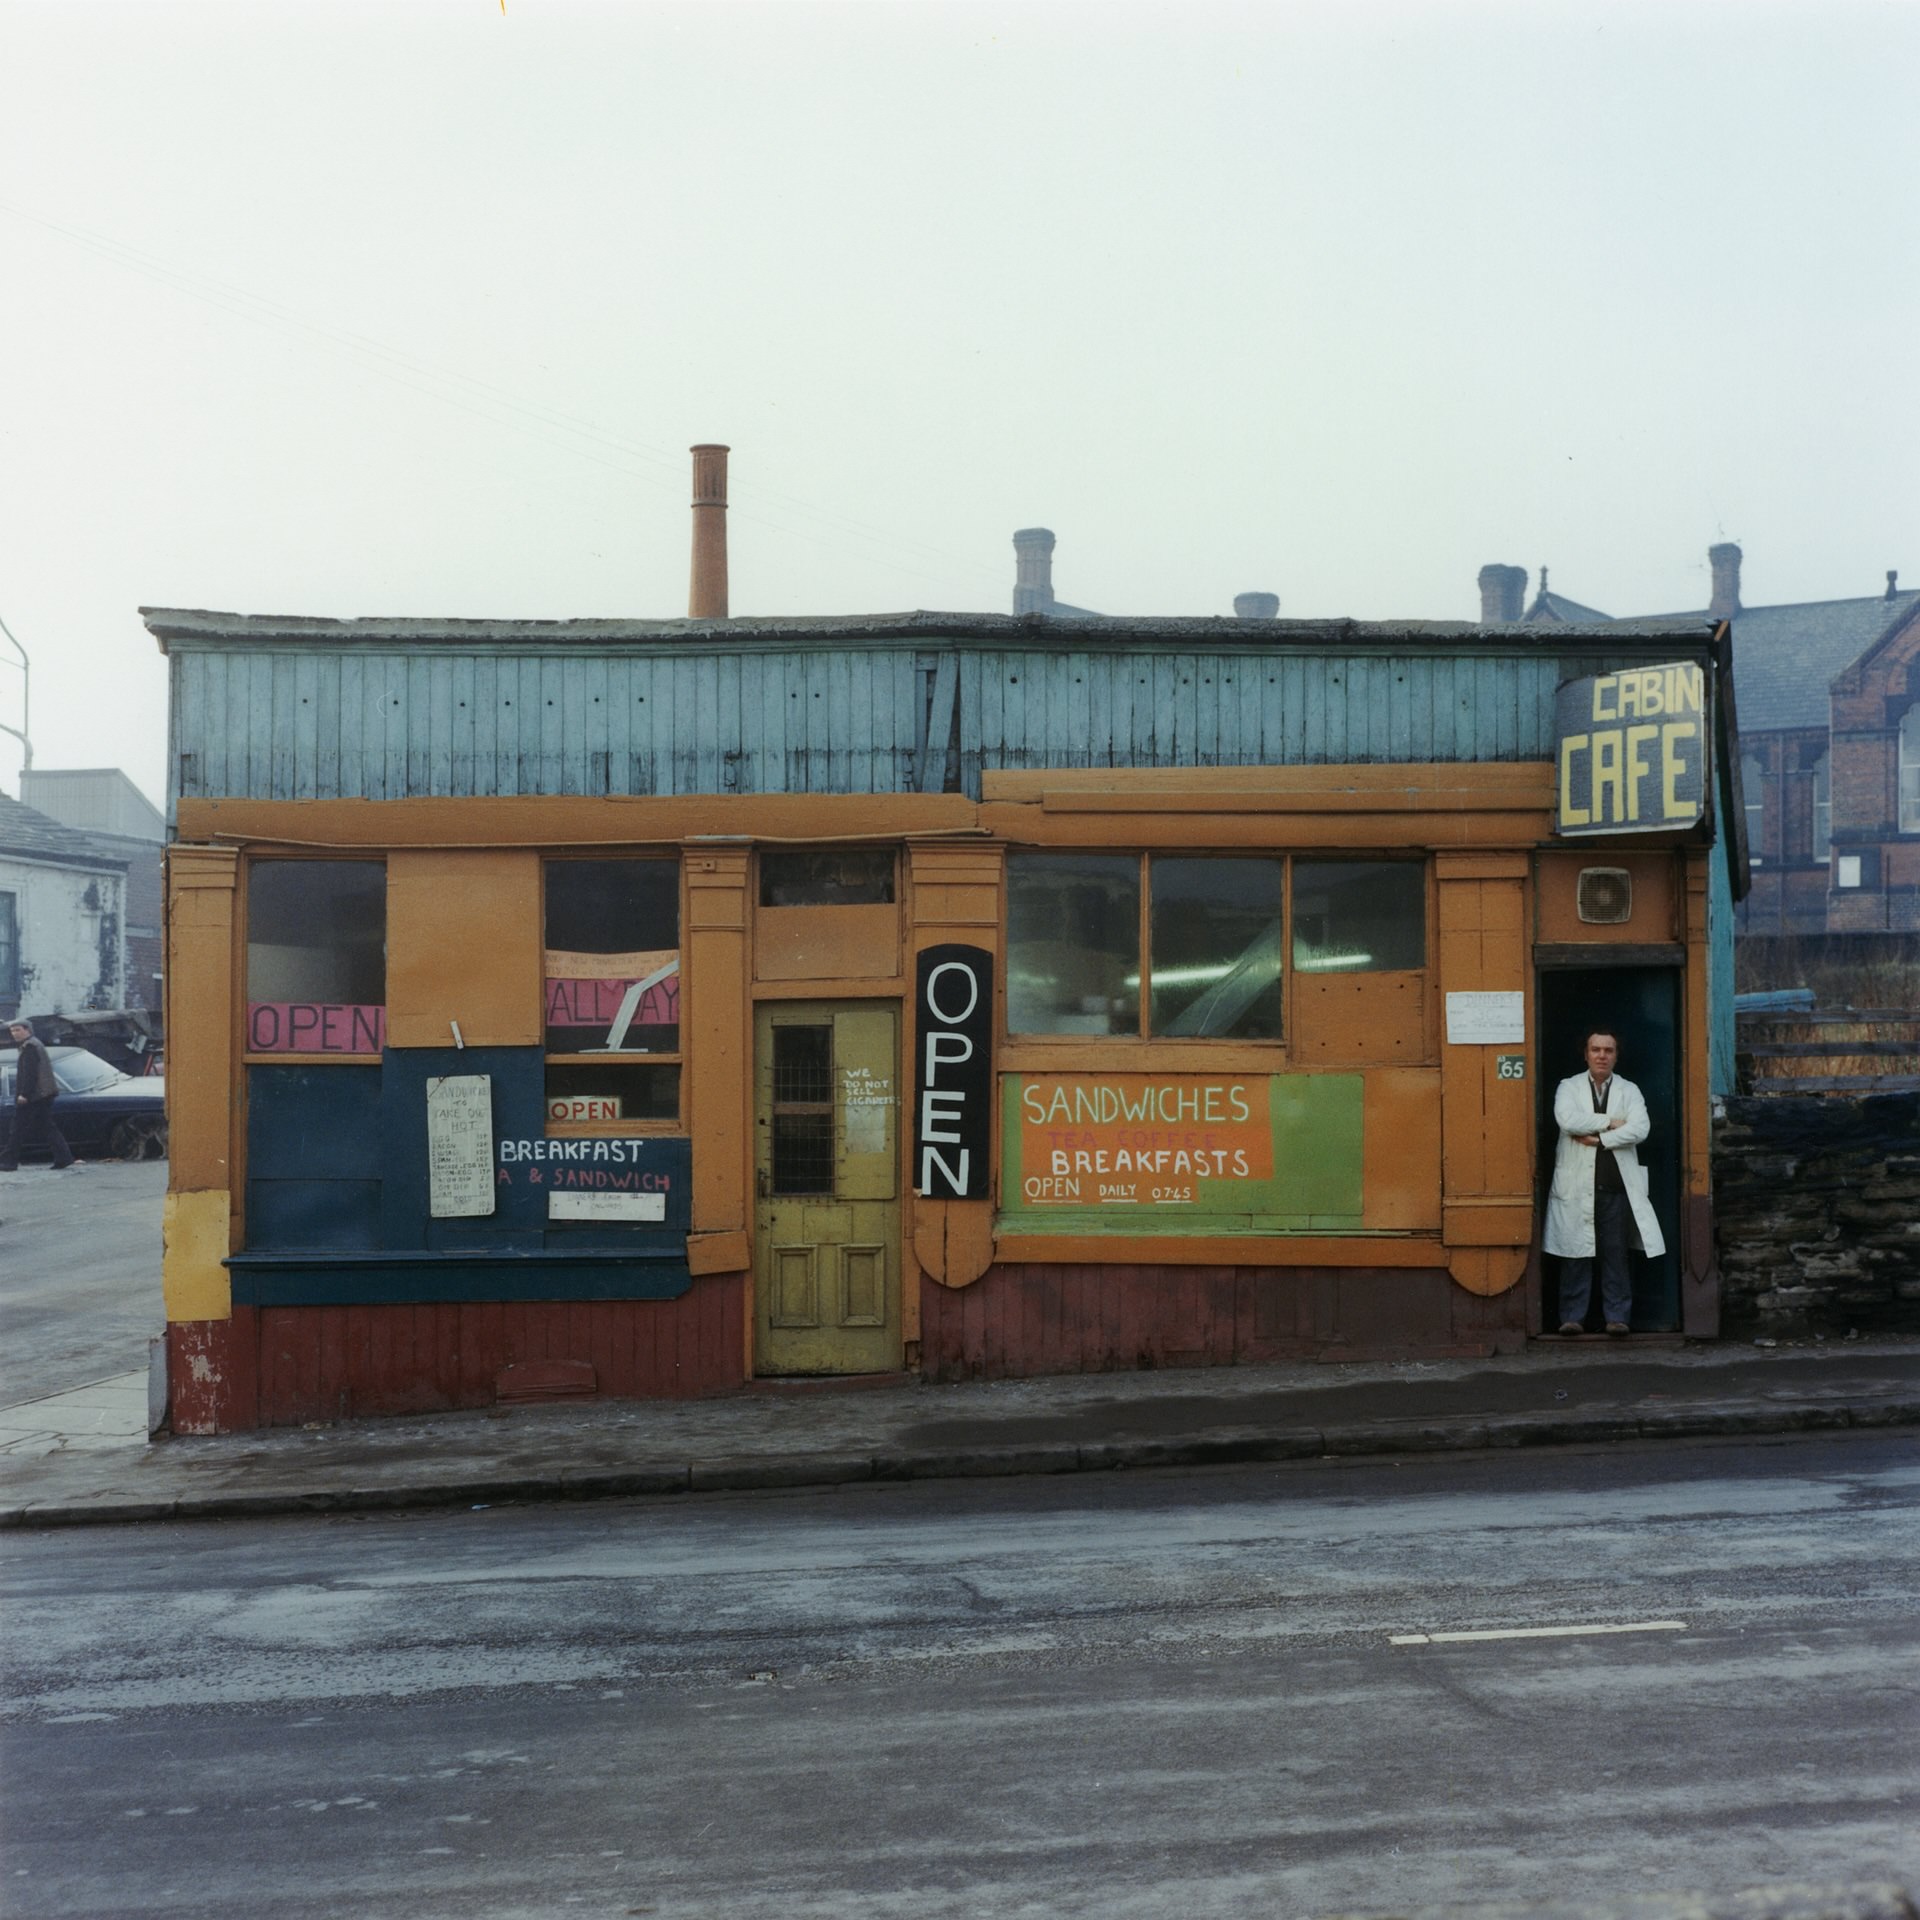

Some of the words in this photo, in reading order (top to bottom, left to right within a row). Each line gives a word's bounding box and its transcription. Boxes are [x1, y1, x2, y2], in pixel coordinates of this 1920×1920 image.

[1592, 666, 1700, 722] CABIN
[1560, 722, 1697, 827] CAFE
[549, 981, 610, 1022] ALL
[252, 1005, 380, 1052] OPEN
[846, 1068, 871, 1078] WE
[921, 961, 978, 1196] OPEN
[1501, 1061, 1524, 1078] 65
[843, 1080, 860, 1088] DO
[865, 1080, 889, 1088] NOT
[846, 1088, 874, 1096] SELL
[551, 1102, 616, 1120] OPEN
[1023, 1085, 1249, 1124] SANDWICHES
[1049, 1131, 1097, 1149] TEA
[1117, 1130, 1216, 1149] COFFEE
[500, 1140, 643, 1163] BREAKFAST
[1052, 1149, 1249, 1177] BREAKFASTS
[553, 1168, 671, 1191] SANDWICH
[1024, 1177, 1080, 1198] OPEN
[1100, 1184, 1137, 1196] DAILY
